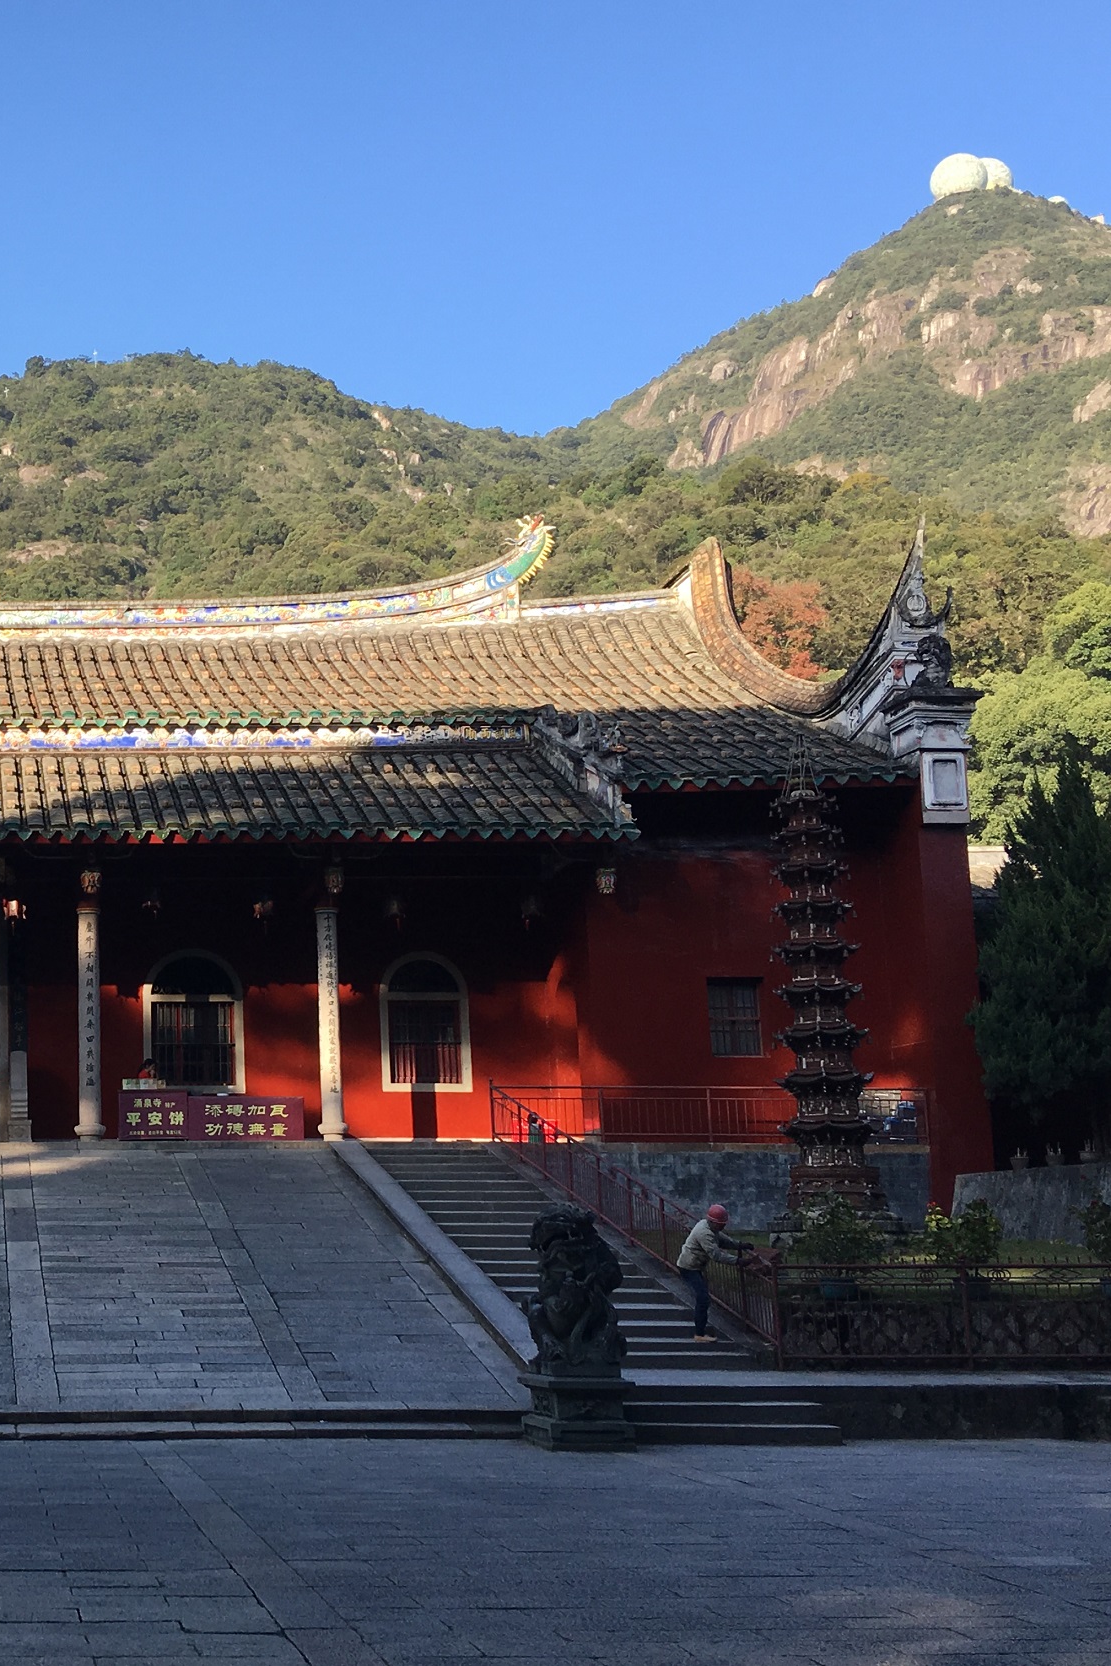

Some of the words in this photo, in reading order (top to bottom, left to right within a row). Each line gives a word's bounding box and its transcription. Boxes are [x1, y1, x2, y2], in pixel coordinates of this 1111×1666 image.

[126, 1111, 184, 1126] 平安饼
[204, 1104, 289, 1118] 添磚加瓦
[204, 1122, 289, 1137] 功德無量
